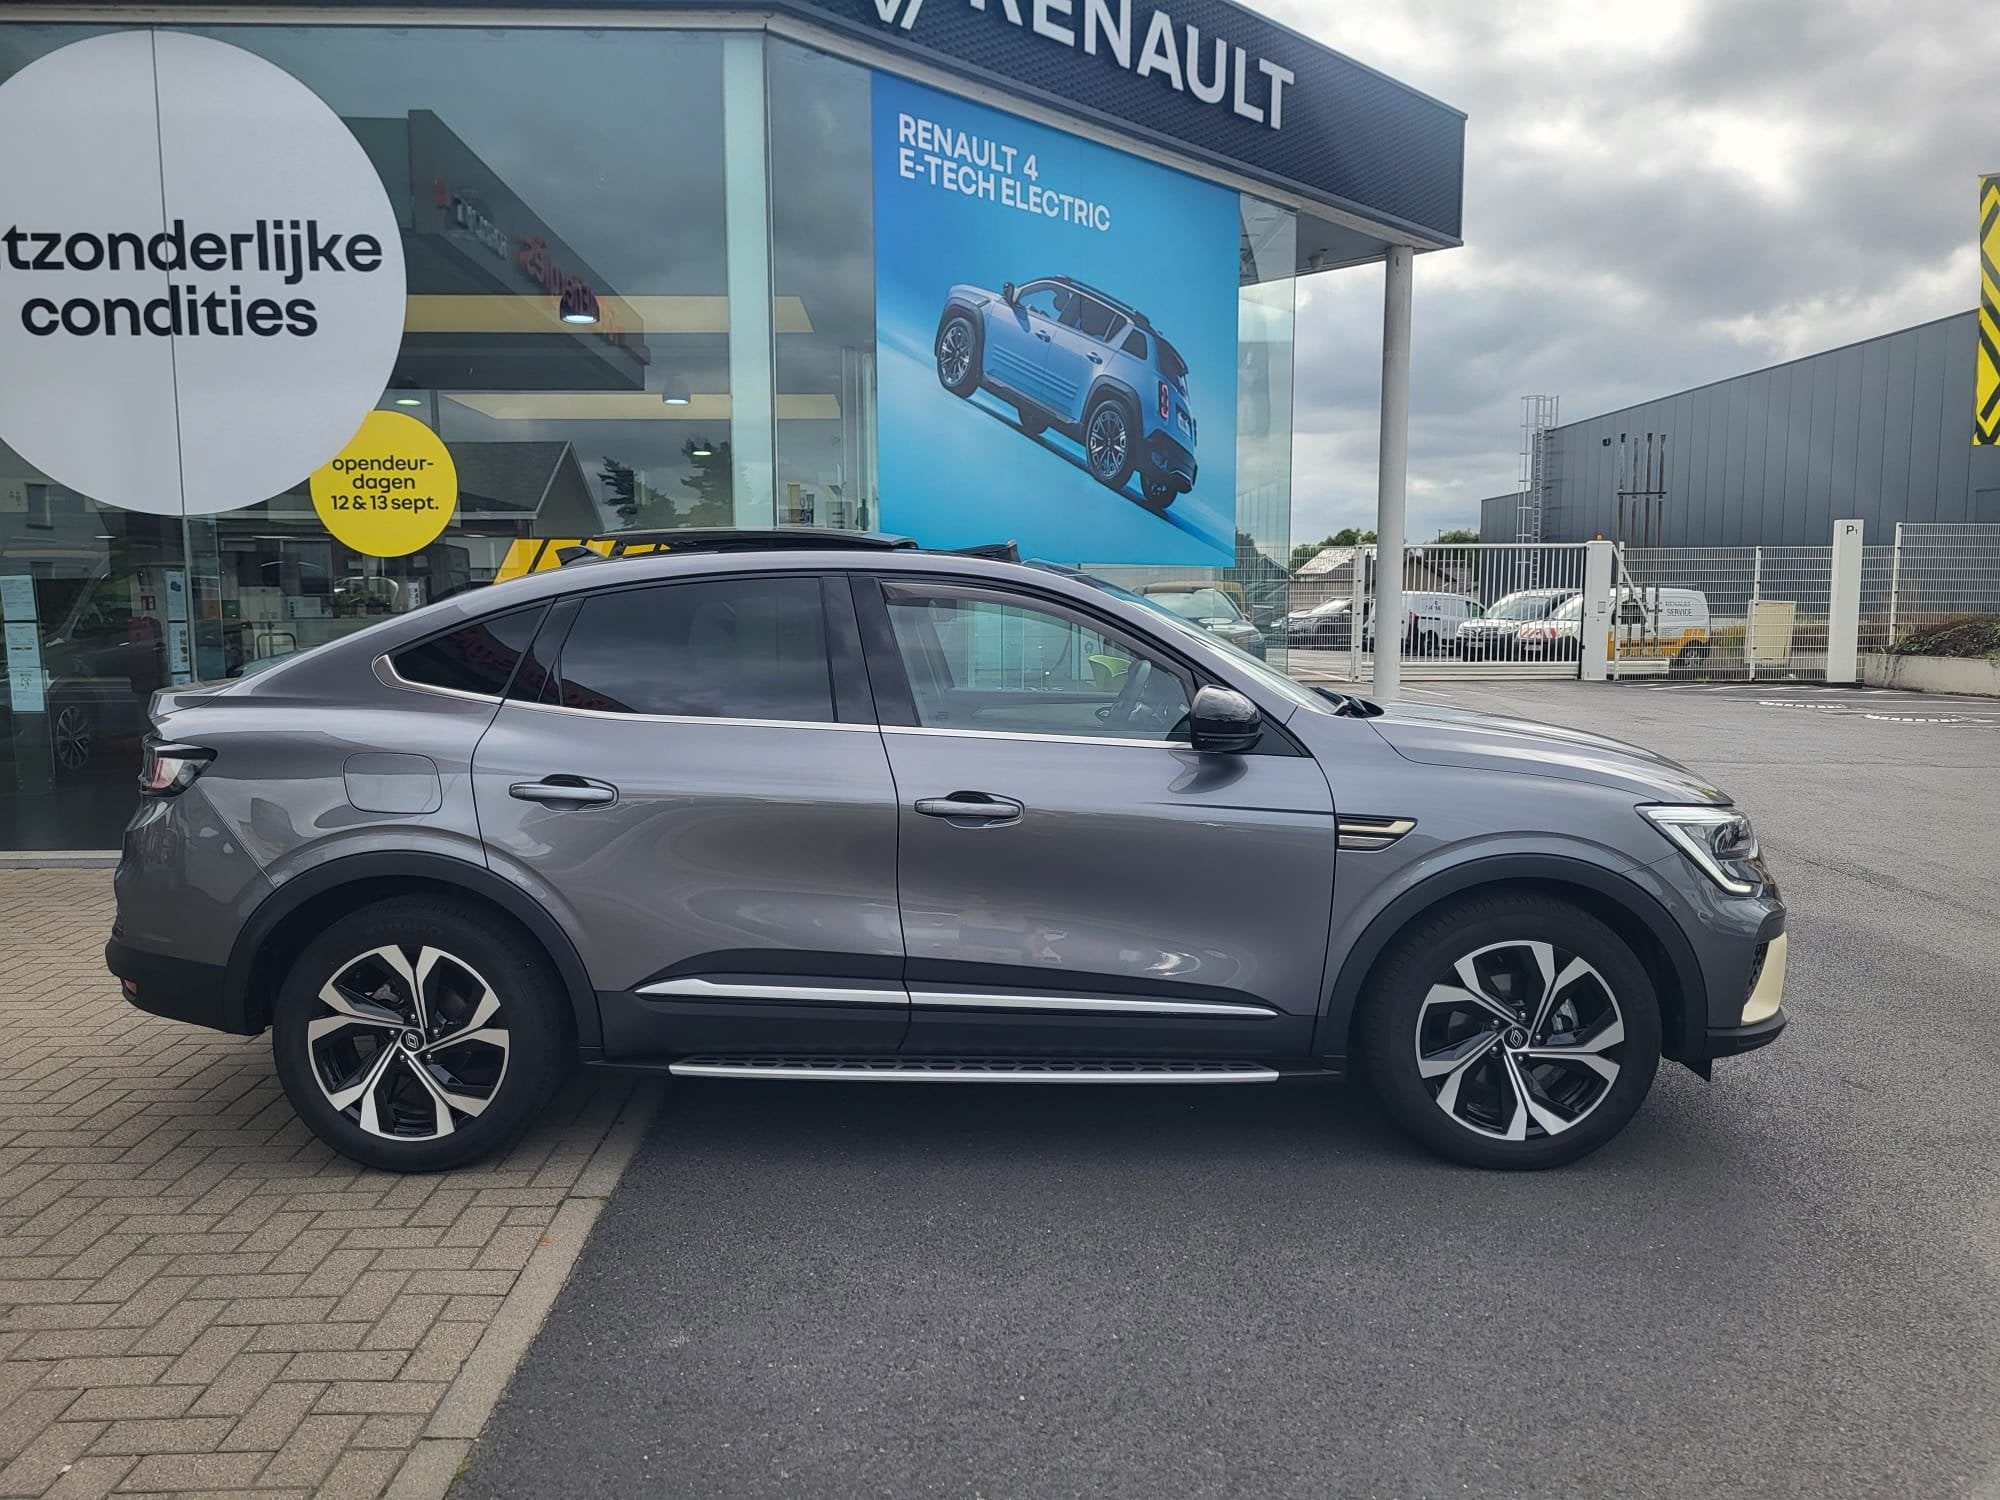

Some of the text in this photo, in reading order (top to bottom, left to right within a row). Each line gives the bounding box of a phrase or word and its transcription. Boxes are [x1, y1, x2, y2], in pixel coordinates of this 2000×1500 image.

[899, 113, 1038, 181] RENAULT 4
[900, 147, 1111, 231] E-TECH ELECTRIC
[0, 219, 383, 285] tzonderlijke
[21, 285, 318, 336] condities
[332, 455, 434, 474] opendeur-
[352, 474, 415, 493] dagen
[331, 495, 439, 514] 12 & 13 sept.
[1666, 608, 1693, 617] SERVICE
